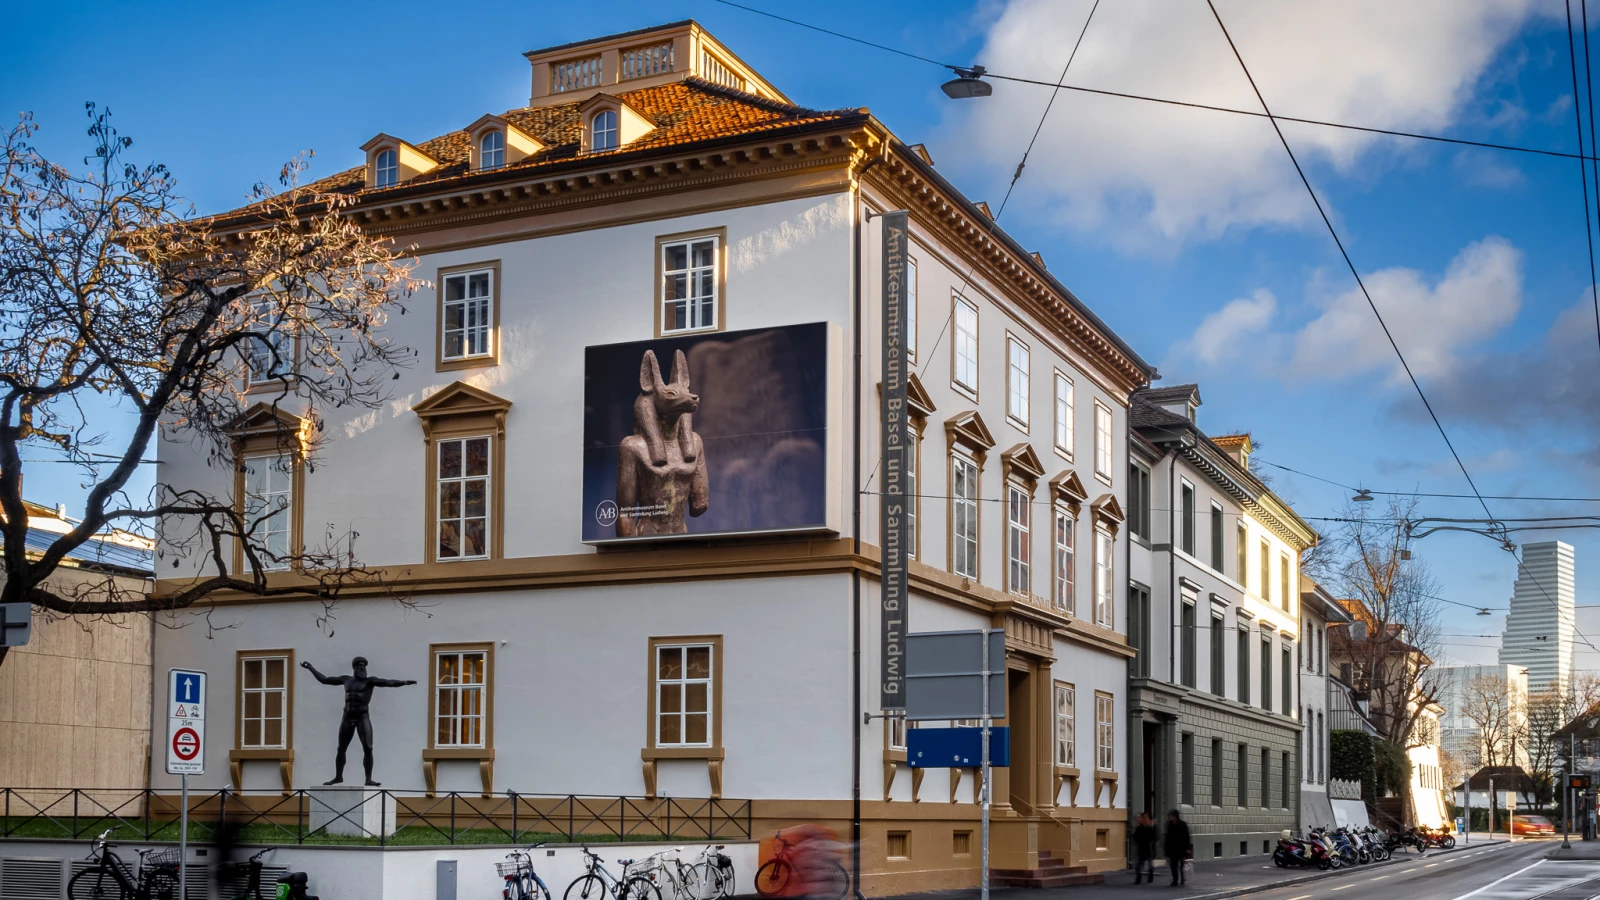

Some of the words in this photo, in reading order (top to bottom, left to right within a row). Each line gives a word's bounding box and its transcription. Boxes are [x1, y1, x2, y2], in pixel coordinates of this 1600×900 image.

[887, 226, 904, 390] Antikenmuseum
[887, 398, 903, 451] Basel
[887, 458, 903, 496] und
[883, 504, 903, 611] Sammlung
[883, 619, 903, 694] Ludwig
